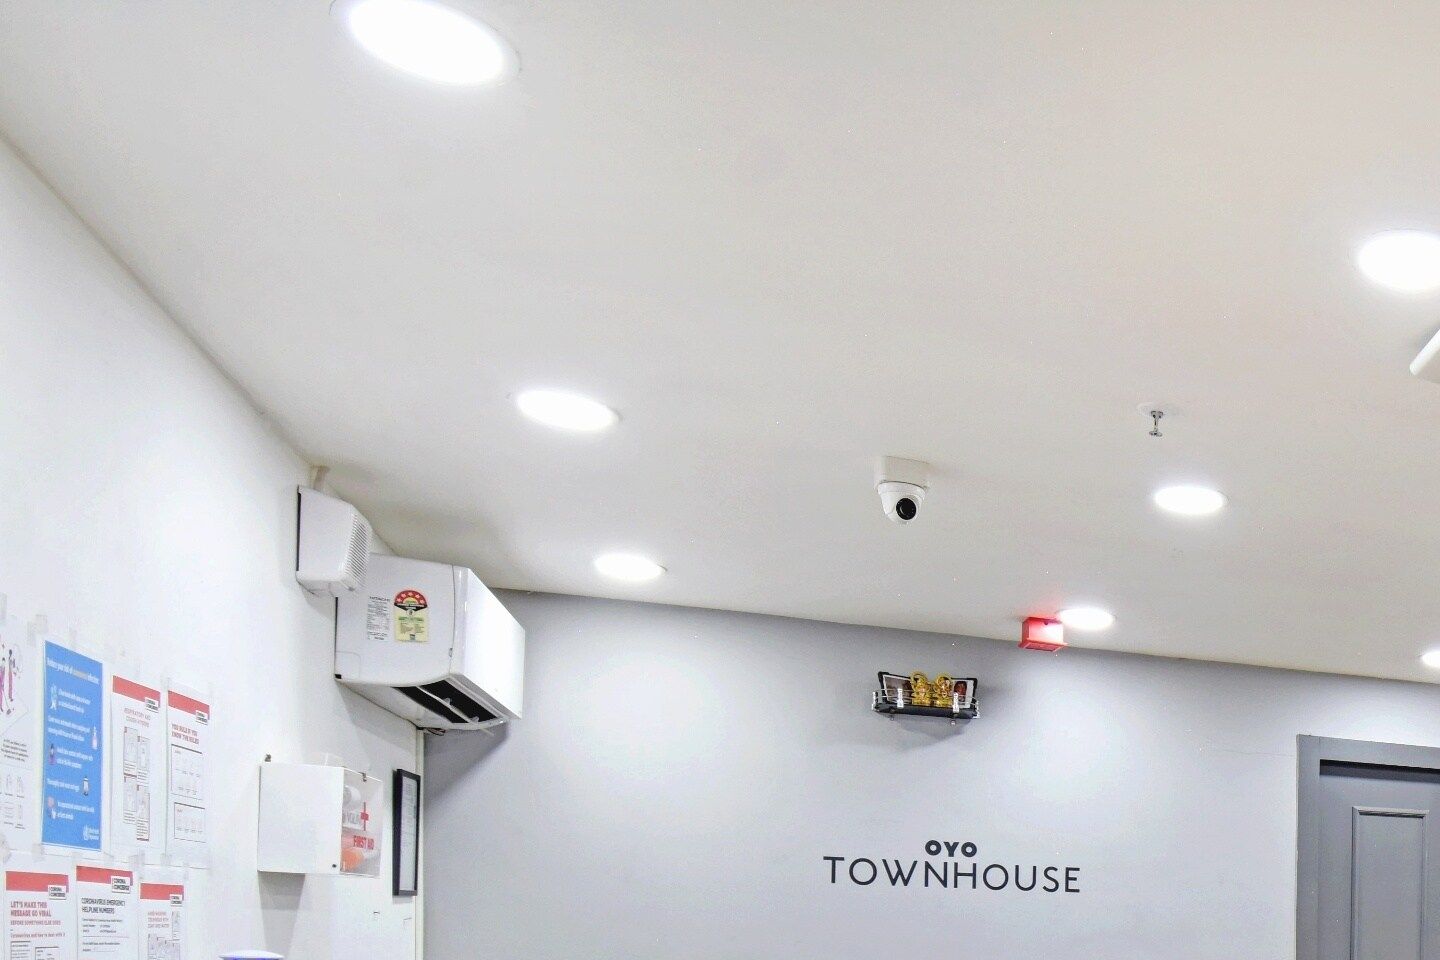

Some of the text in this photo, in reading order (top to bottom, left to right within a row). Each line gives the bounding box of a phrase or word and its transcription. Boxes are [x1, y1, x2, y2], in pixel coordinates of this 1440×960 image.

[924, 839, 978, 858] OYO
[823, 856, 1081, 893] TOWNHOUSE
[24, 901, 37, 909] MAKE
